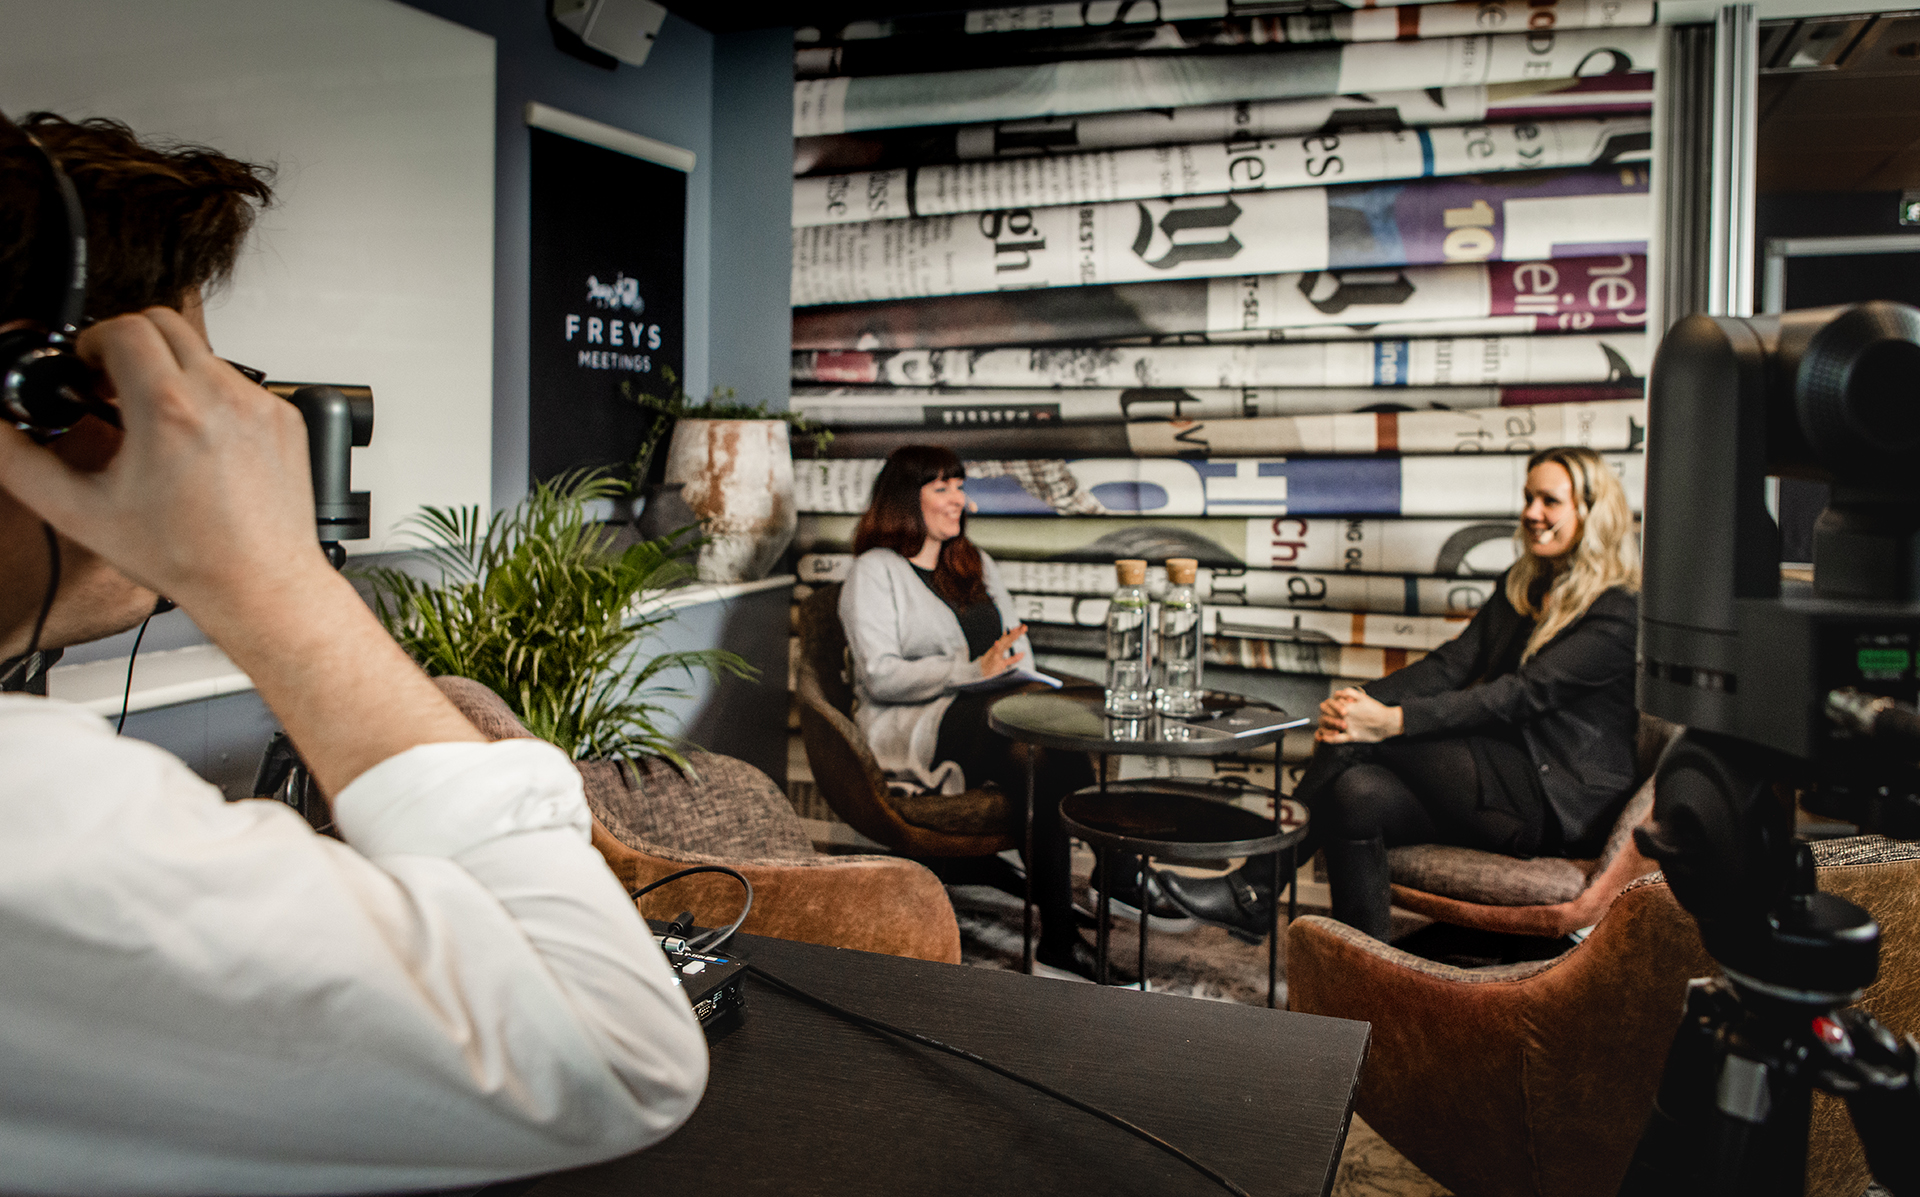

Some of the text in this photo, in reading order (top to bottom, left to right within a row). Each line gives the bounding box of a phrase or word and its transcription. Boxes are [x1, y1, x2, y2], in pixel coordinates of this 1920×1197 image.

[1444, 201, 1495, 261] 10
[566, 314, 660, 350] FREYS
[578, 351, 652, 372] MEETINGS
